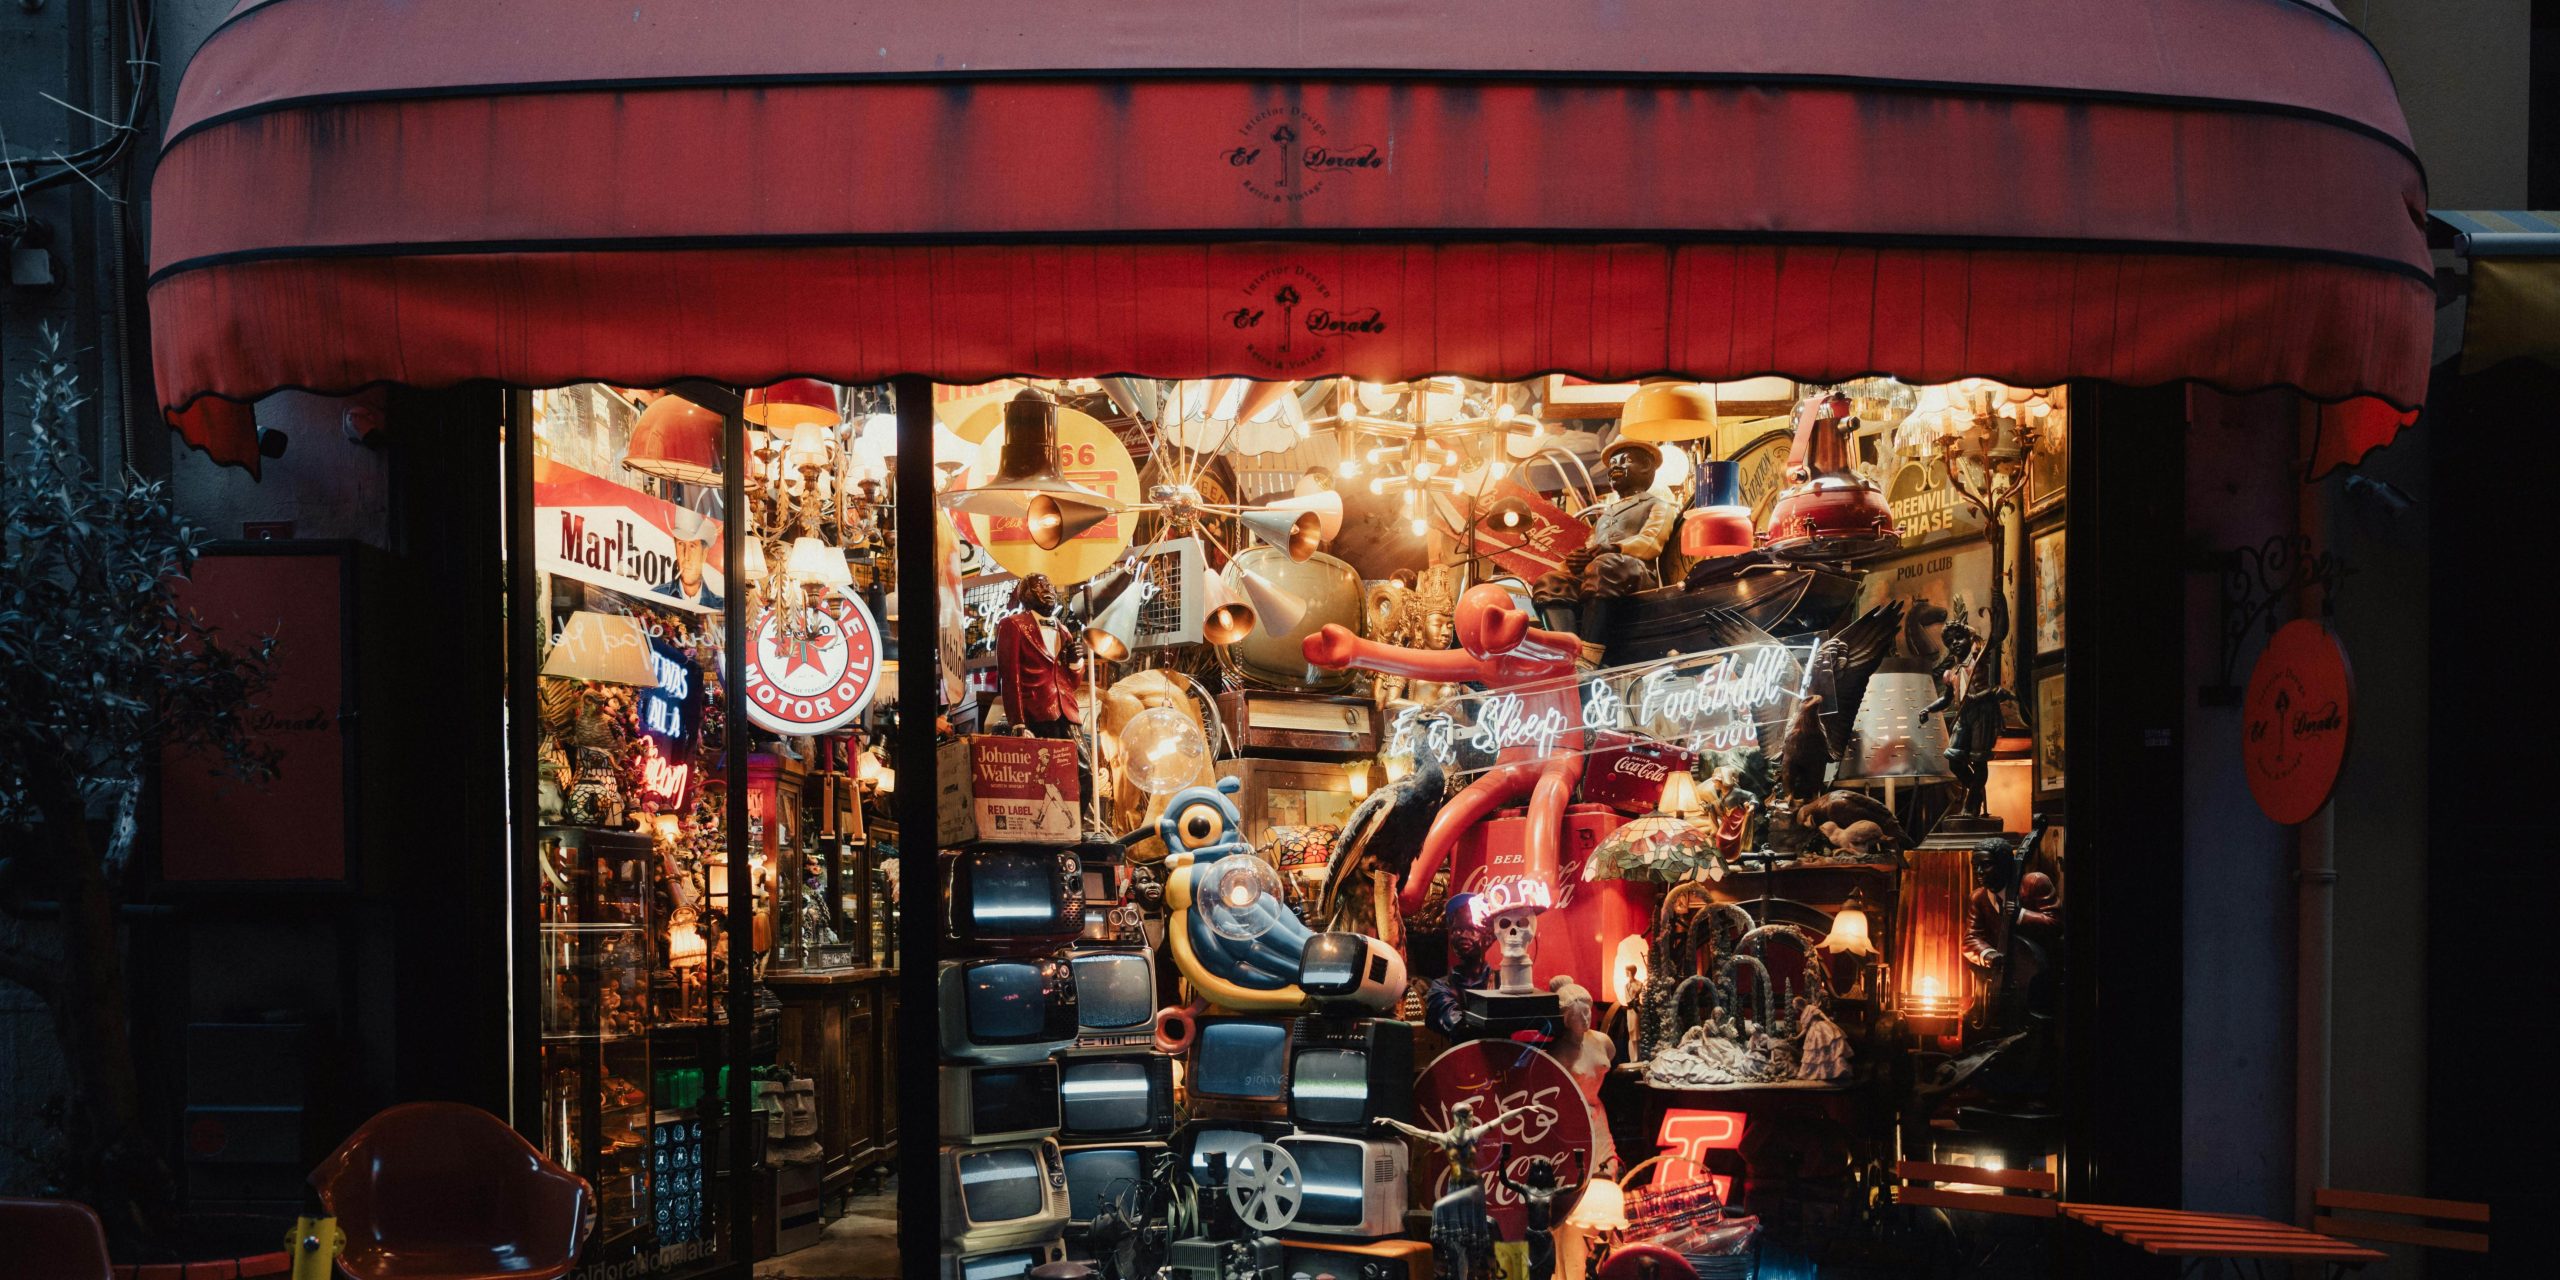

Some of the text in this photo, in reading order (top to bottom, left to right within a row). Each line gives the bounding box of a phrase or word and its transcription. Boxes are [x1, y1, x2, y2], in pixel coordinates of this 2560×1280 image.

[1239, 106, 1328, 136] Interior Design
[1220, 144, 1383, 174] El Dorado
[1242, 265, 1331, 298] Interior Design
[1223, 307, 1387, 340] El Dorado
[1897, 557, 1953, 580] POLO CLUB
[746, 656, 869, 719] MOTOR OIL
[1472, 692, 1563, 759] Sleep
[1583, 678, 1617, 729] &
[2293, 701, 2341, 741] Dorado
[978, 745, 1032, 764] Johnnie
[1614, 756, 1669, 782] Coca-Cola
[980, 764, 1032, 783] Walker
[988, 805, 1033, 816] RED LABEL
[1493, 854, 1525, 865] BEB
